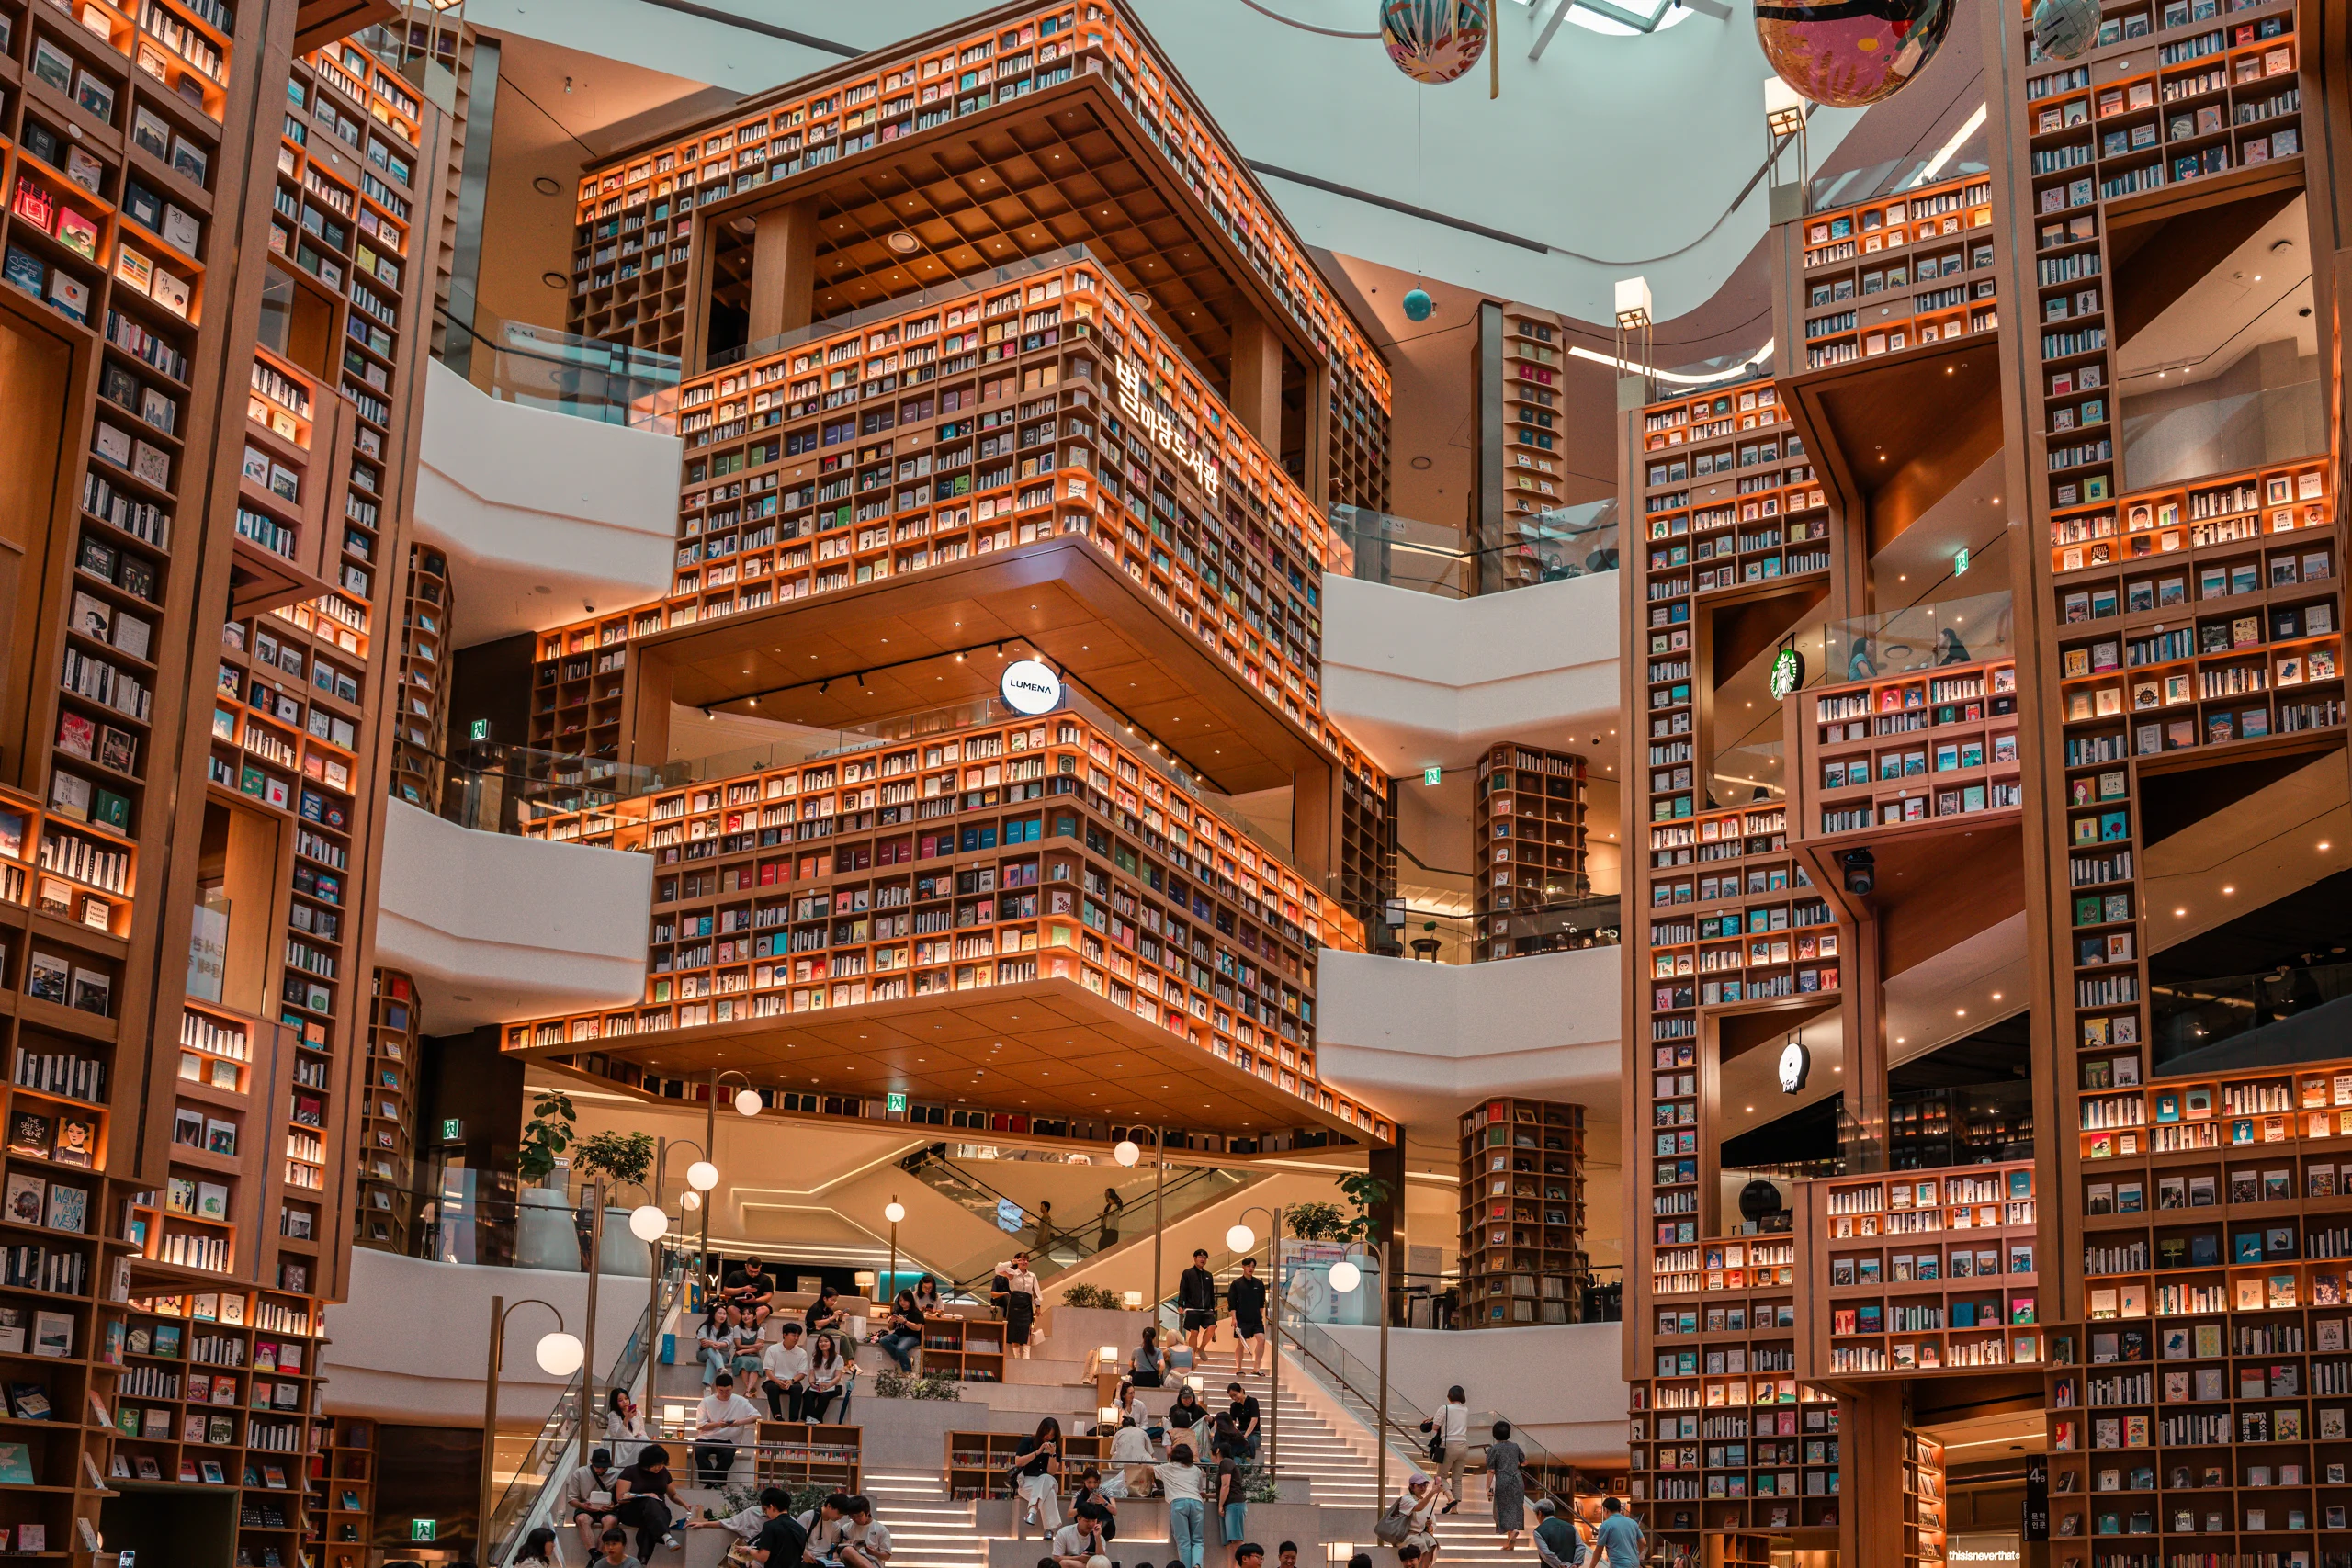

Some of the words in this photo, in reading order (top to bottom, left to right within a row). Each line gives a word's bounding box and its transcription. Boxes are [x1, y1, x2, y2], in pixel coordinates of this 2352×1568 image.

[1114, 355, 1219, 498] 별마당도서관
[354, 570, 362, 584] AI
[1010, 679, 1052, 694] LUMENA
[20, 1121, 45, 1133] SELFSH
[27, 1116, 40, 1125] THE
[21, 1129, 42, 1139] GENE
